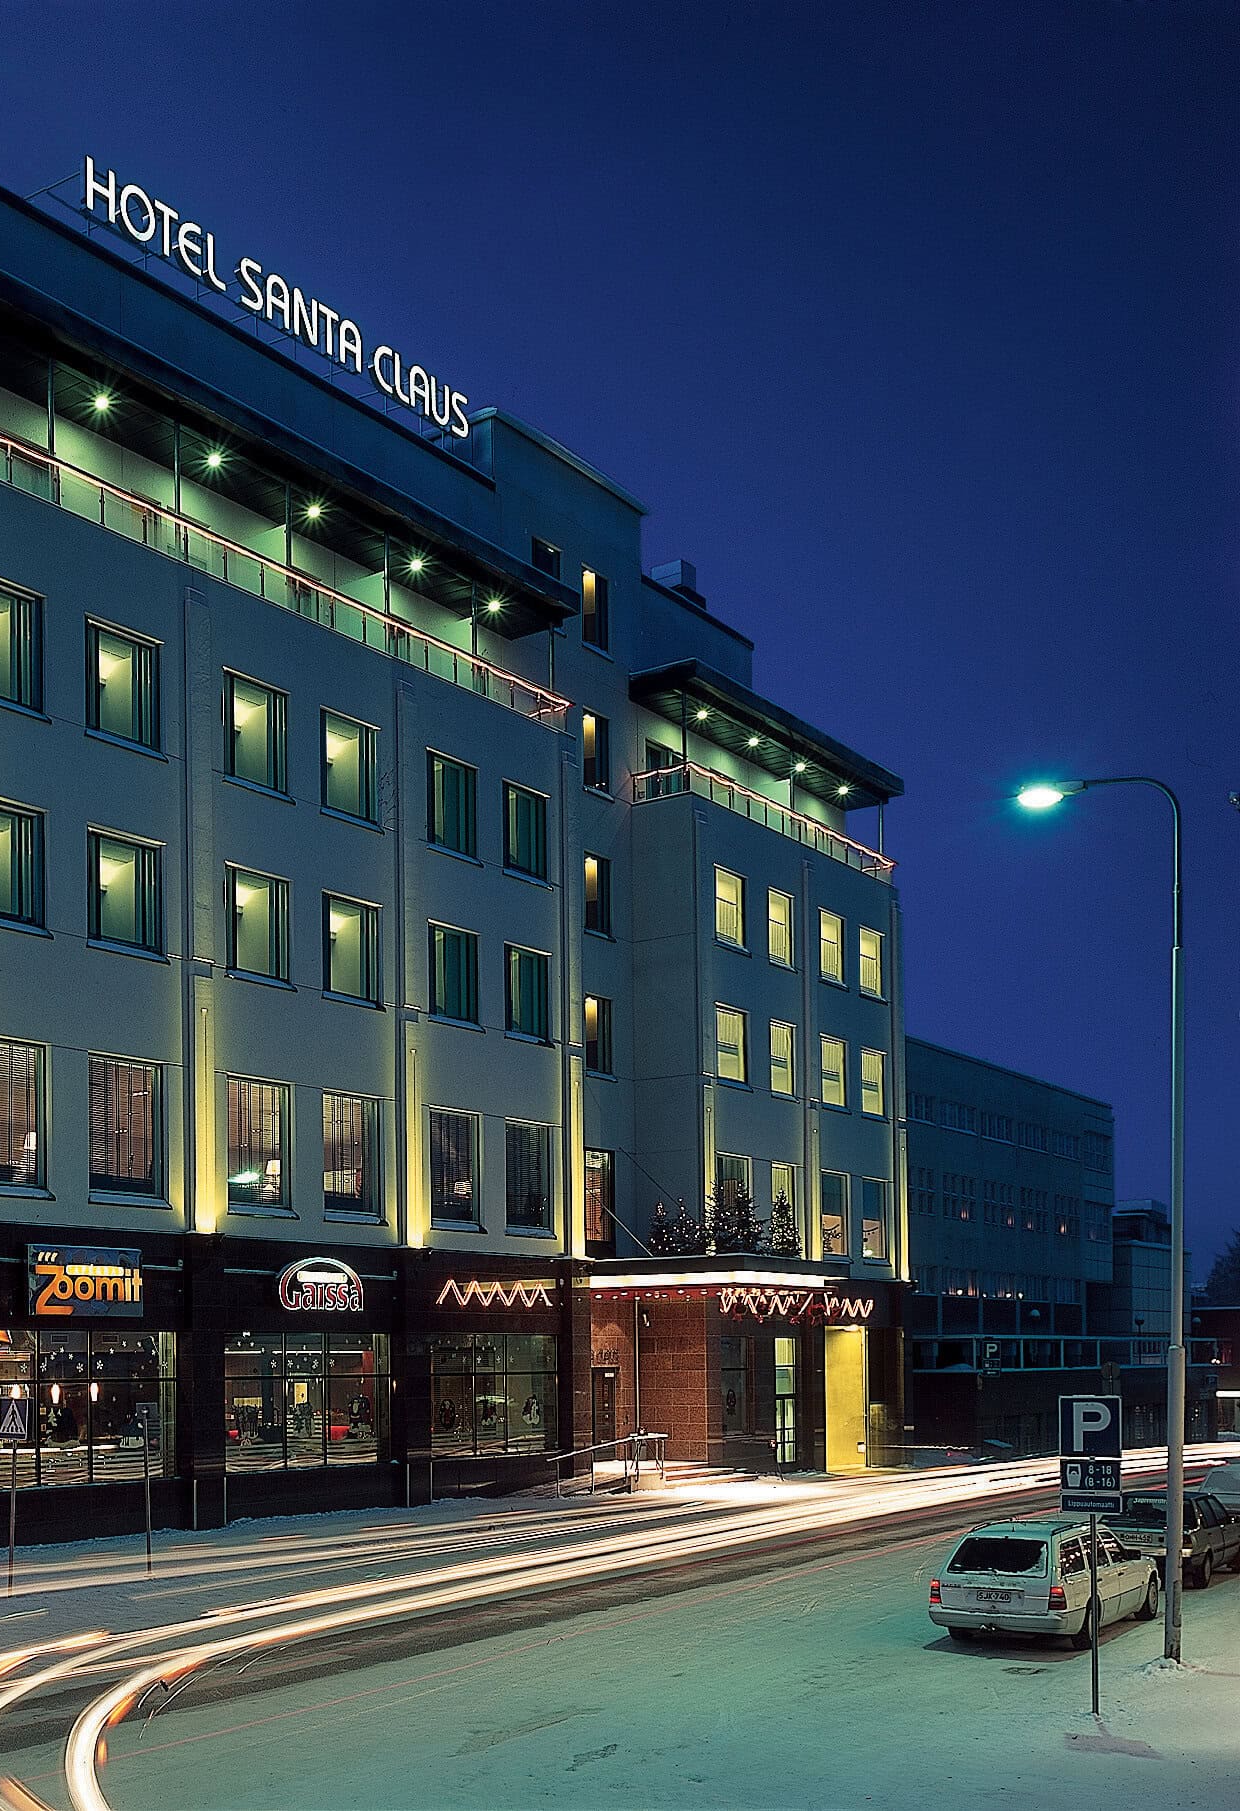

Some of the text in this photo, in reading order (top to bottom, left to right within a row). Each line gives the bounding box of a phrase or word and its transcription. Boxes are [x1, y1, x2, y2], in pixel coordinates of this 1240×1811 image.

[85, 154, 470, 439] HOTEL SANTA CLAUS
[35, 1264, 142, 1315] Zoomit
[279, 1257, 364, 1311] Gaissa
[986, 1343, 998, 1358] P
[1073, 1402, 1111, 1452] P
